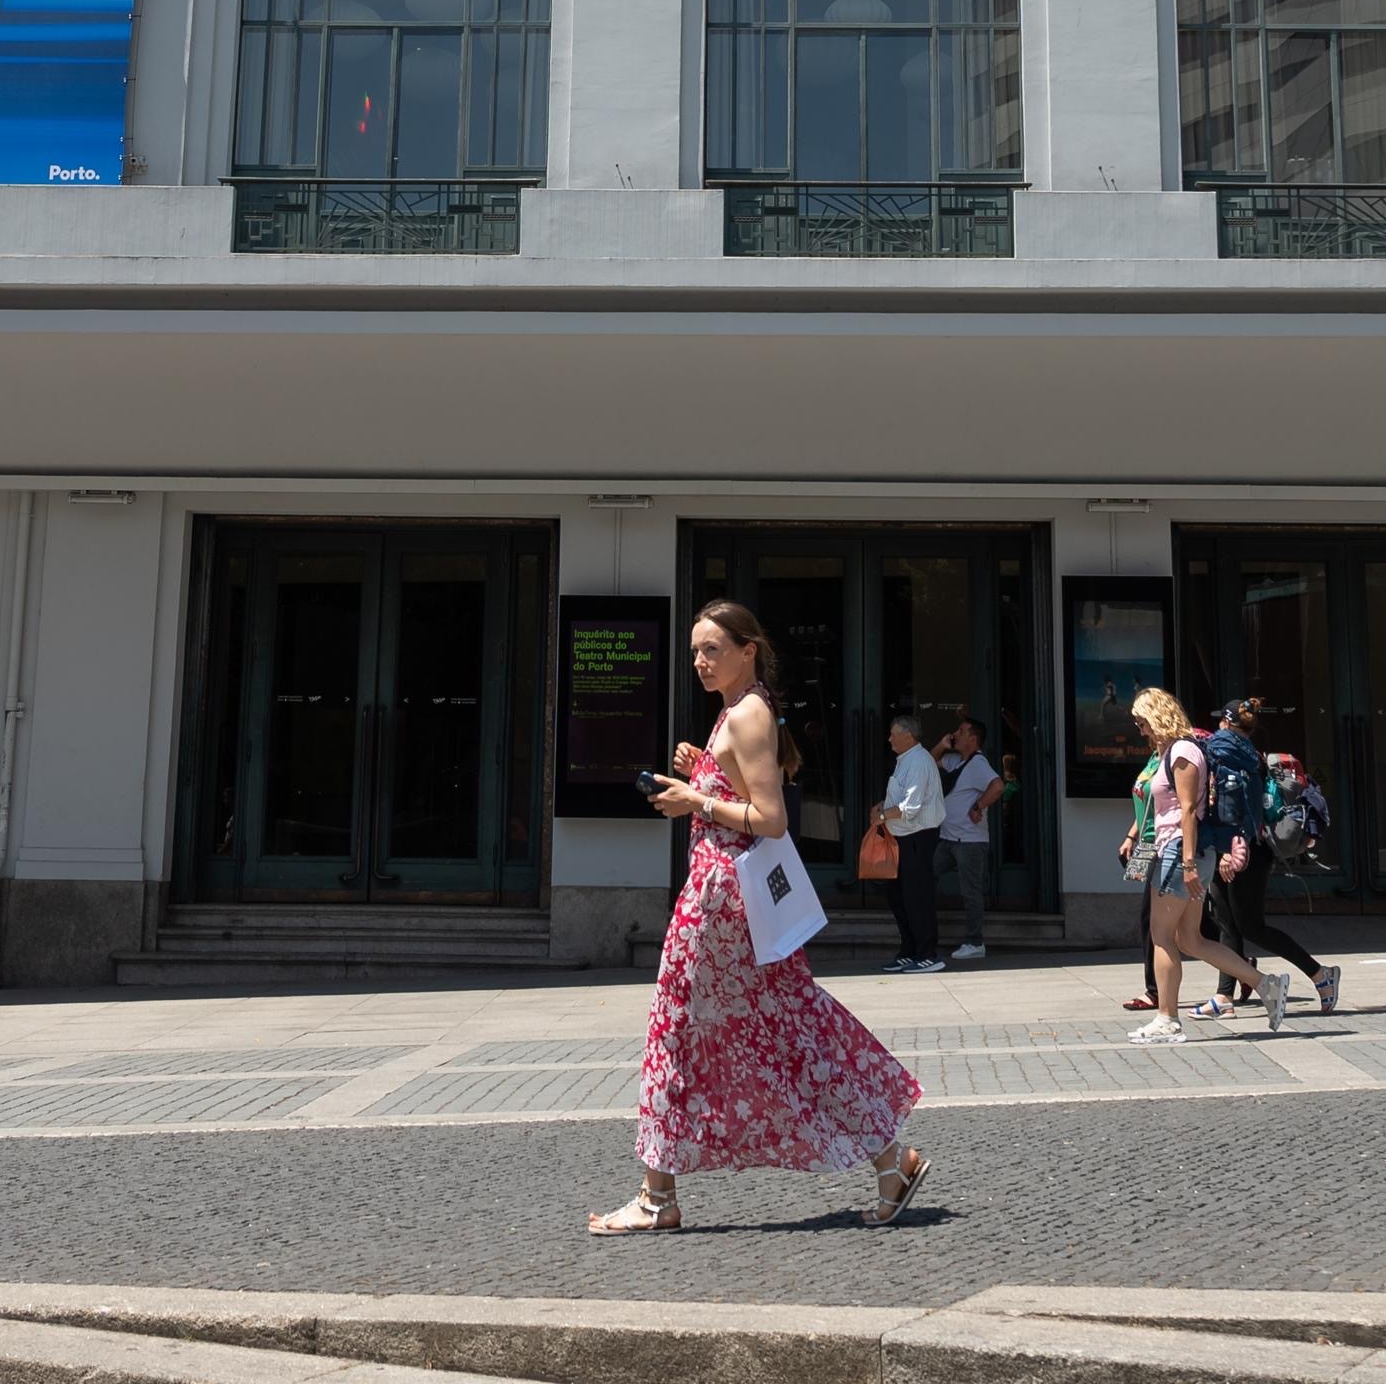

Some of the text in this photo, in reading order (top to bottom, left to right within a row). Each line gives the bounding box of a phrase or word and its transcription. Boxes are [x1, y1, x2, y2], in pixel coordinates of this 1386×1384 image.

[49, 165, 100, 180] Porto.
[574, 629, 635, 640] Inquérito aos
[573, 640, 627, 653] públicos do
[574, 651, 651, 662] Teatro Municipal
[573, 662, 613, 671] do Porto
